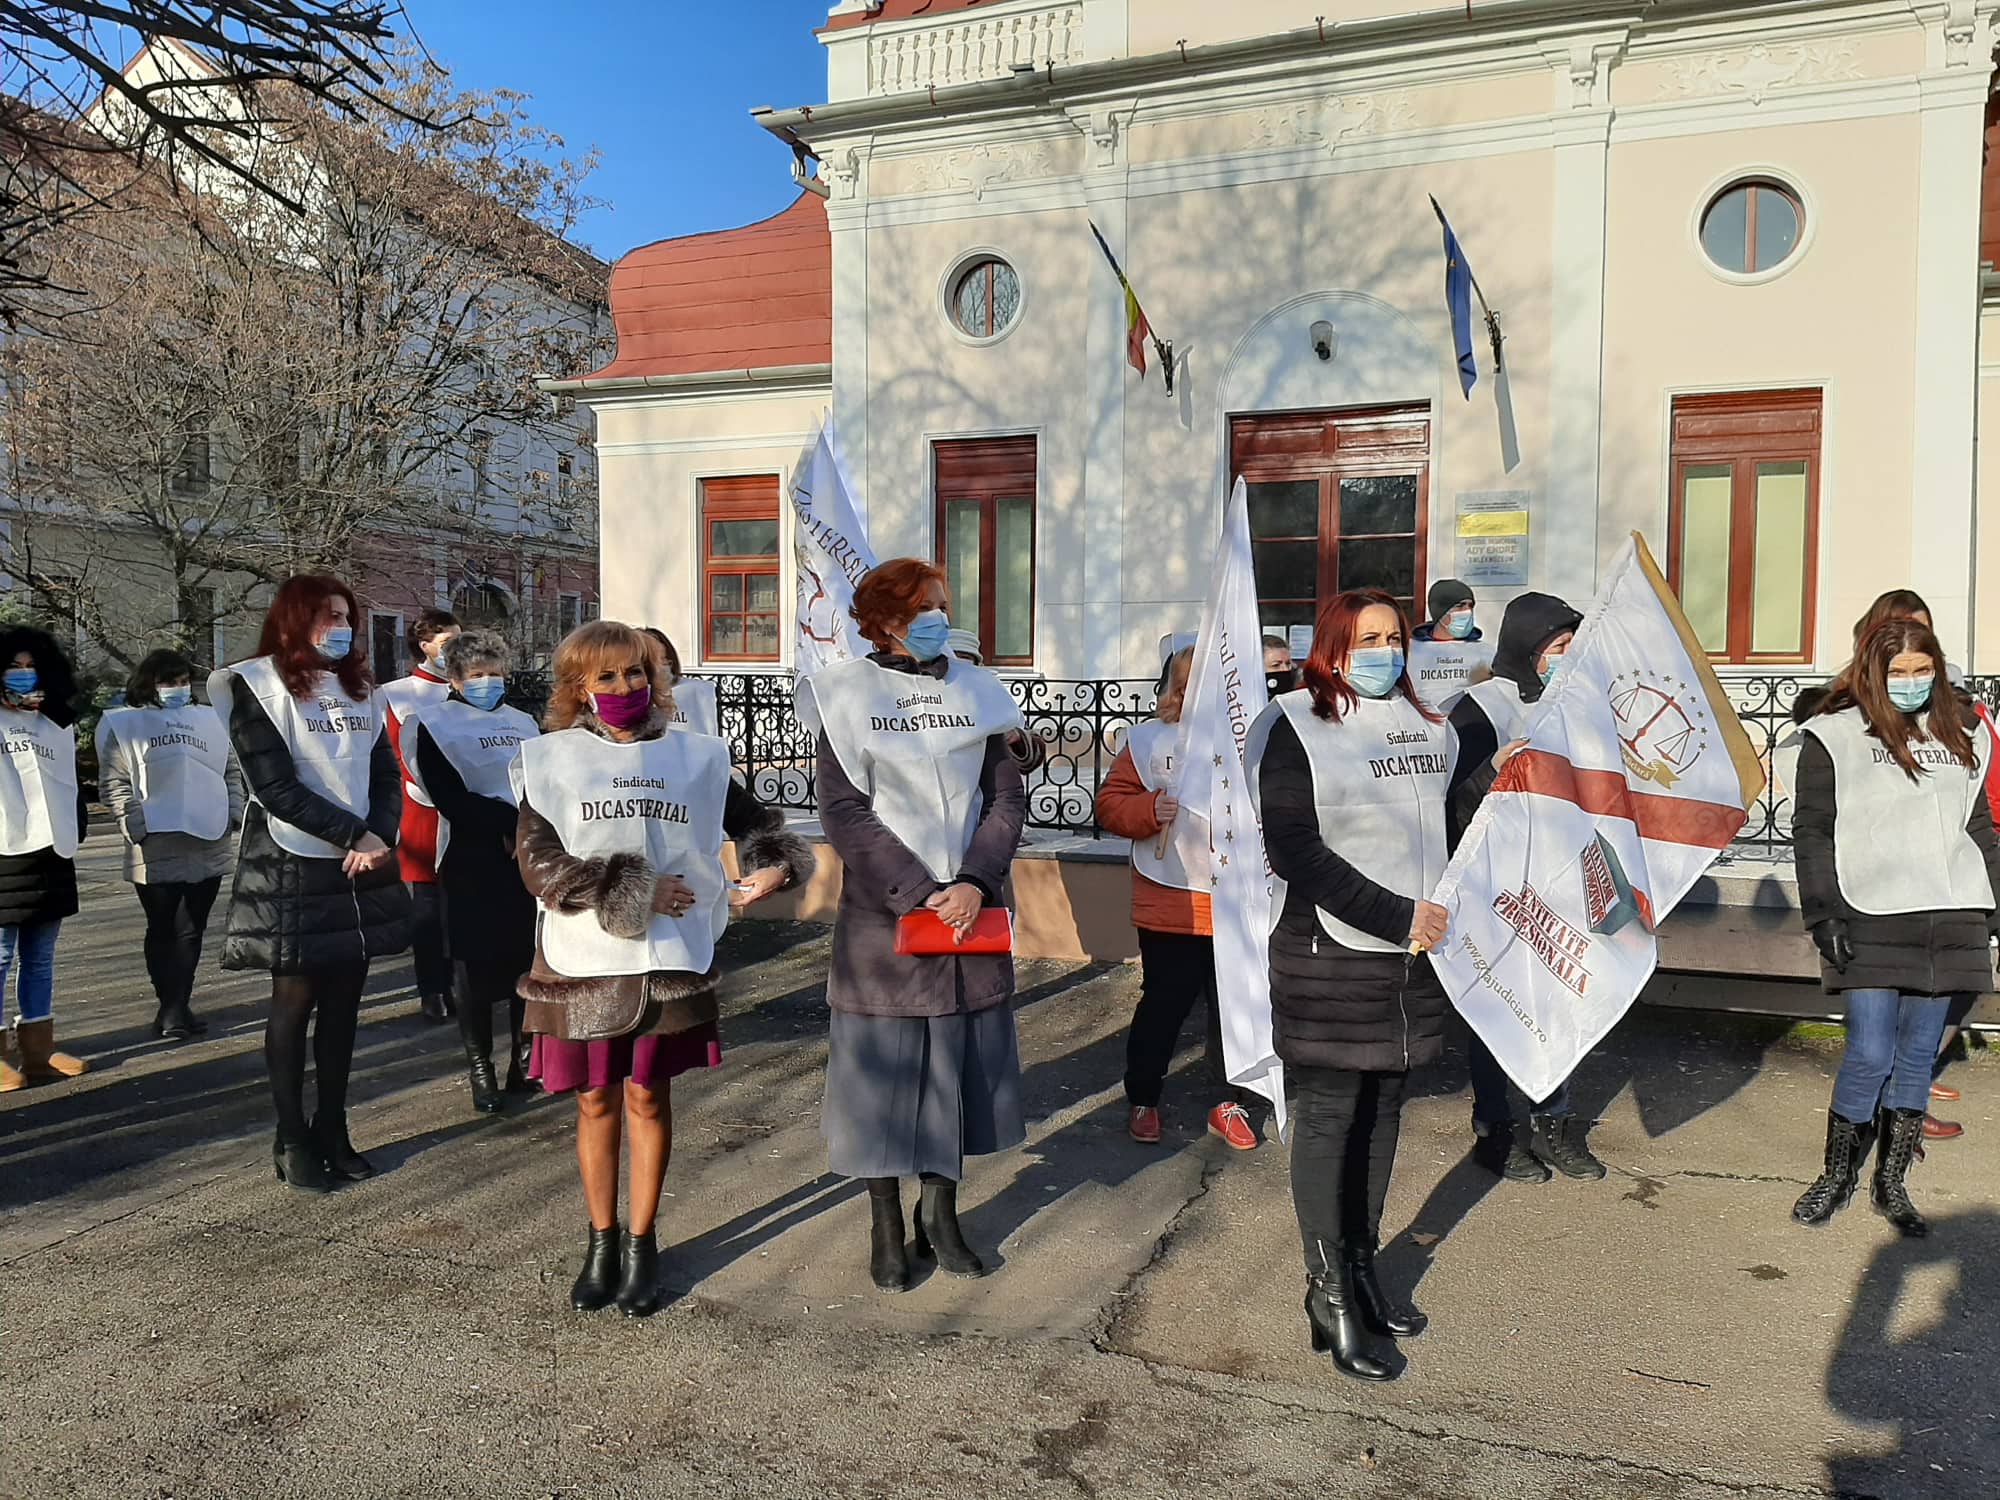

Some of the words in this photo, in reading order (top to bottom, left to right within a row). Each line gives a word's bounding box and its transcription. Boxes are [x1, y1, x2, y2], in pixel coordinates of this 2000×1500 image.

[896, 693, 942, 709] Sindicatul
[870, 713, 975, 732] DICASTERIAL
[612, 776, 665, 789] Sindicatul
[581, 799, 689, 824] DICASTERIAL
